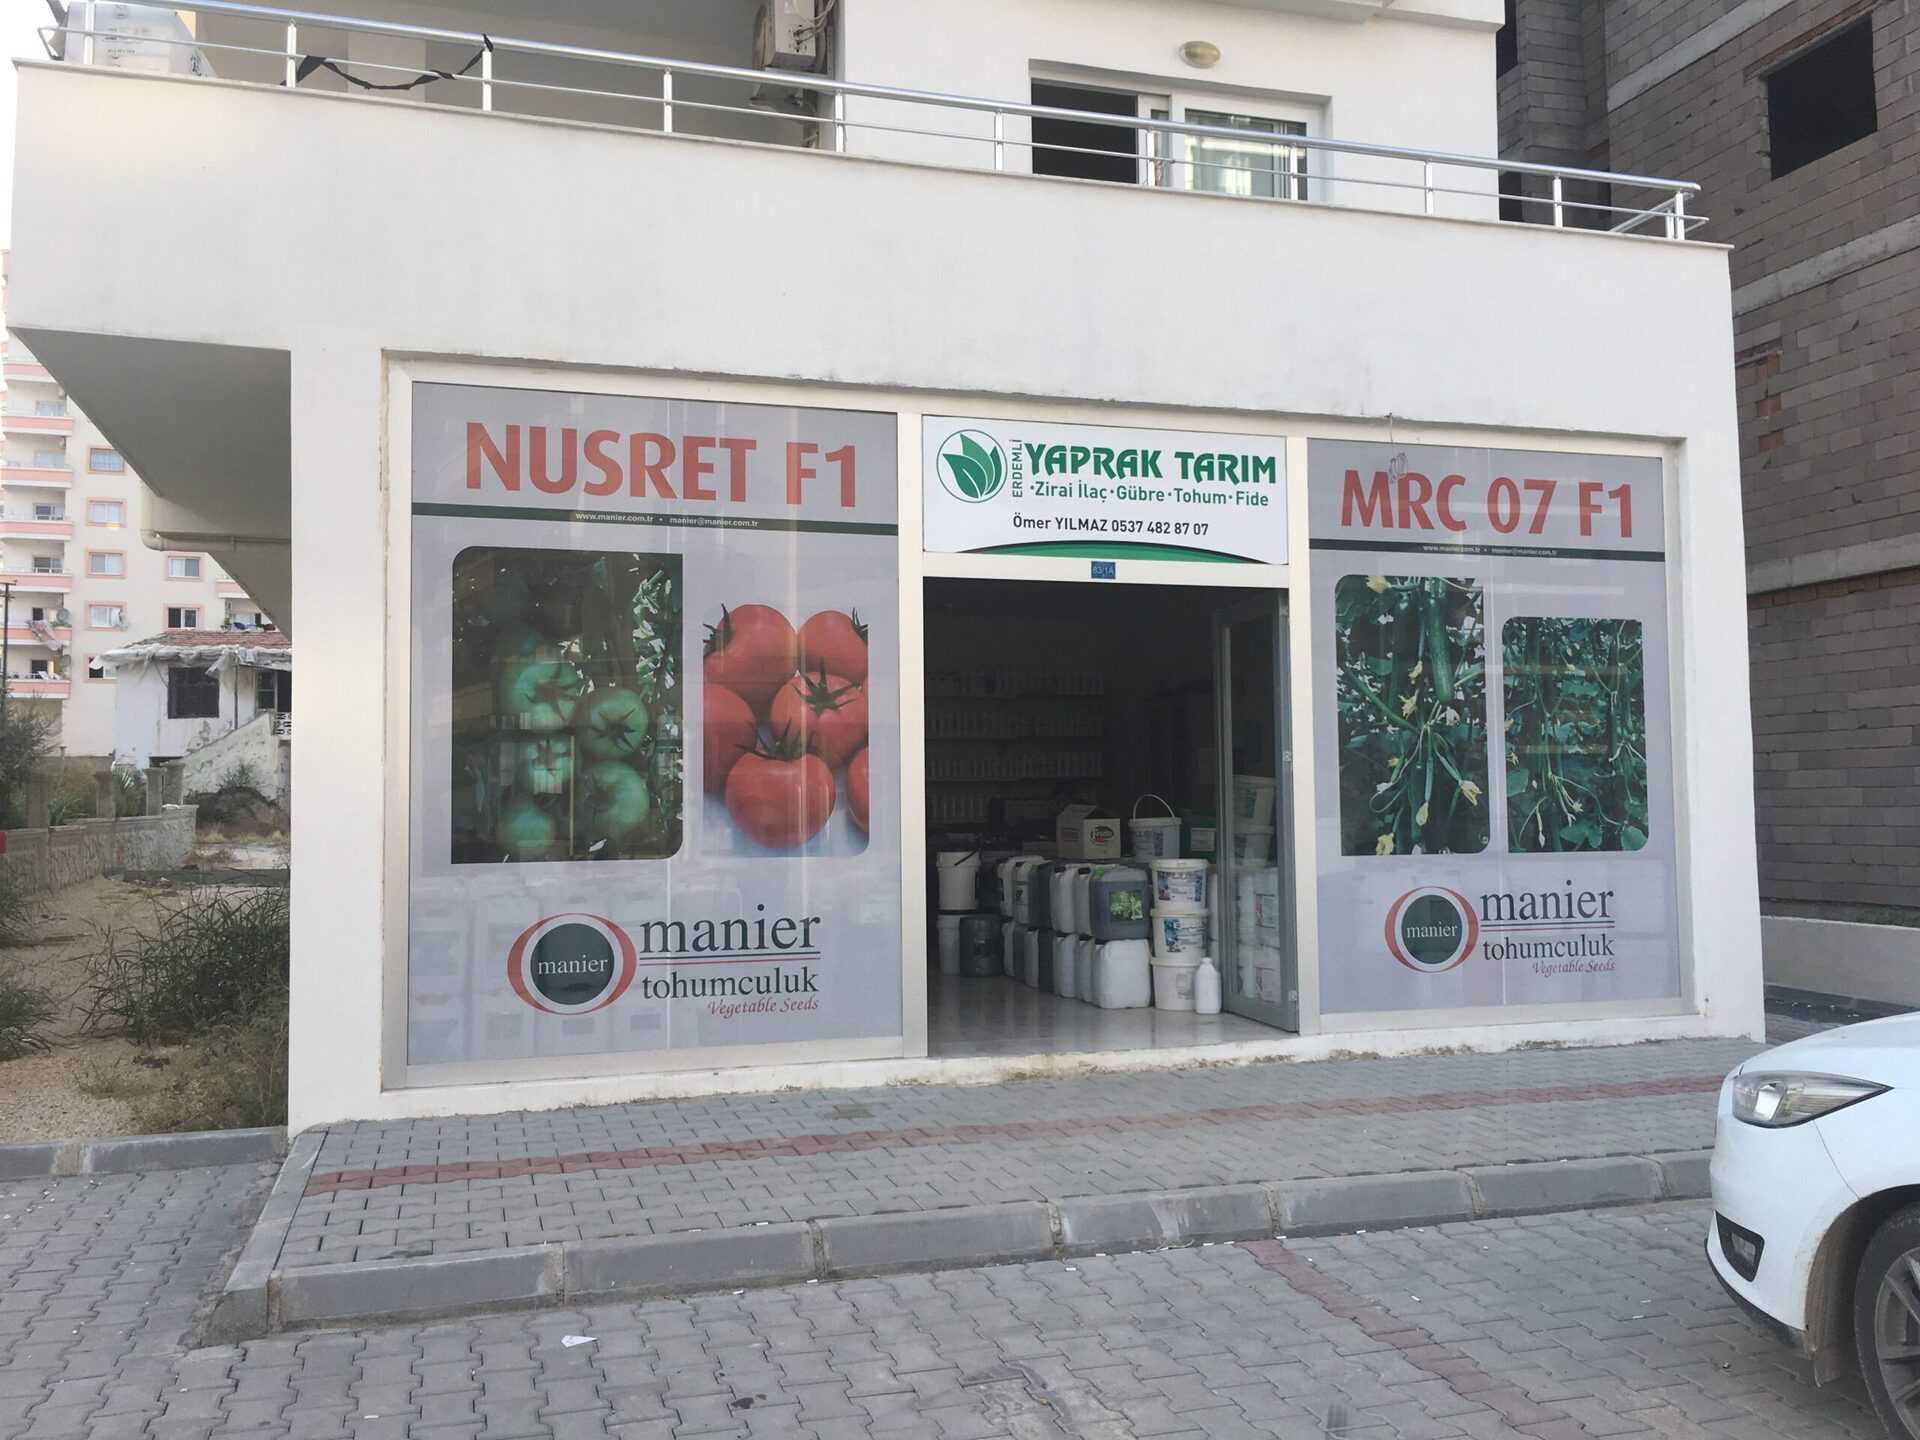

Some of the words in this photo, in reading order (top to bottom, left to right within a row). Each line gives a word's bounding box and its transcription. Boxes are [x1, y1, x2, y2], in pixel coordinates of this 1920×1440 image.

[466, 422, 757, 502] NUSRET
[786, 442, 856, 507] F1
[1009, 439, 1023, 498] ERDEMLİ
[1024, 443, 1163, 480] YAPRAK
[1174, 451, 1276, 485] TARIM
[1035, 481, 1073, 497] Zirai
[1078, 480, 1107, 503] İlaç
[1116, 485, 1165, 502] Gübre
[1174, 488, 1227, 505] Tohum
[1236, 491, 1269, 506] Fide
[1341, 469, 1468, 532] MRC
[1487, 477, 1558, 534] 07
[1578, 482, 1633, 538] F1
[1013, 512, 1050, 529] Ömer
[1055, 516, 1108, 532] YILMAZ
[1112, 519, 1143, 533] 0537
[1147, 521, 1171, 534] 482
[1174, 522, 1190, 535] 87
[1193, 522, 1209, 536] 07
[1480, 880, 1614, 921] manier
[639, 904, 820, 953] manier
[1406, 921, 1458, 939] manier
[1483, 934, 1615, 960] tohumculuk
[538, 954, 608, 975] manier
[1532, 958, 1583, 978] Vegetable
[1587, 960, 1616, 972] Seeds
[642, 966, 819, 999] tohumculuk
[708, 997, 777, 1019] Vegetable
[779, 996, 819, 1013] Seeds
